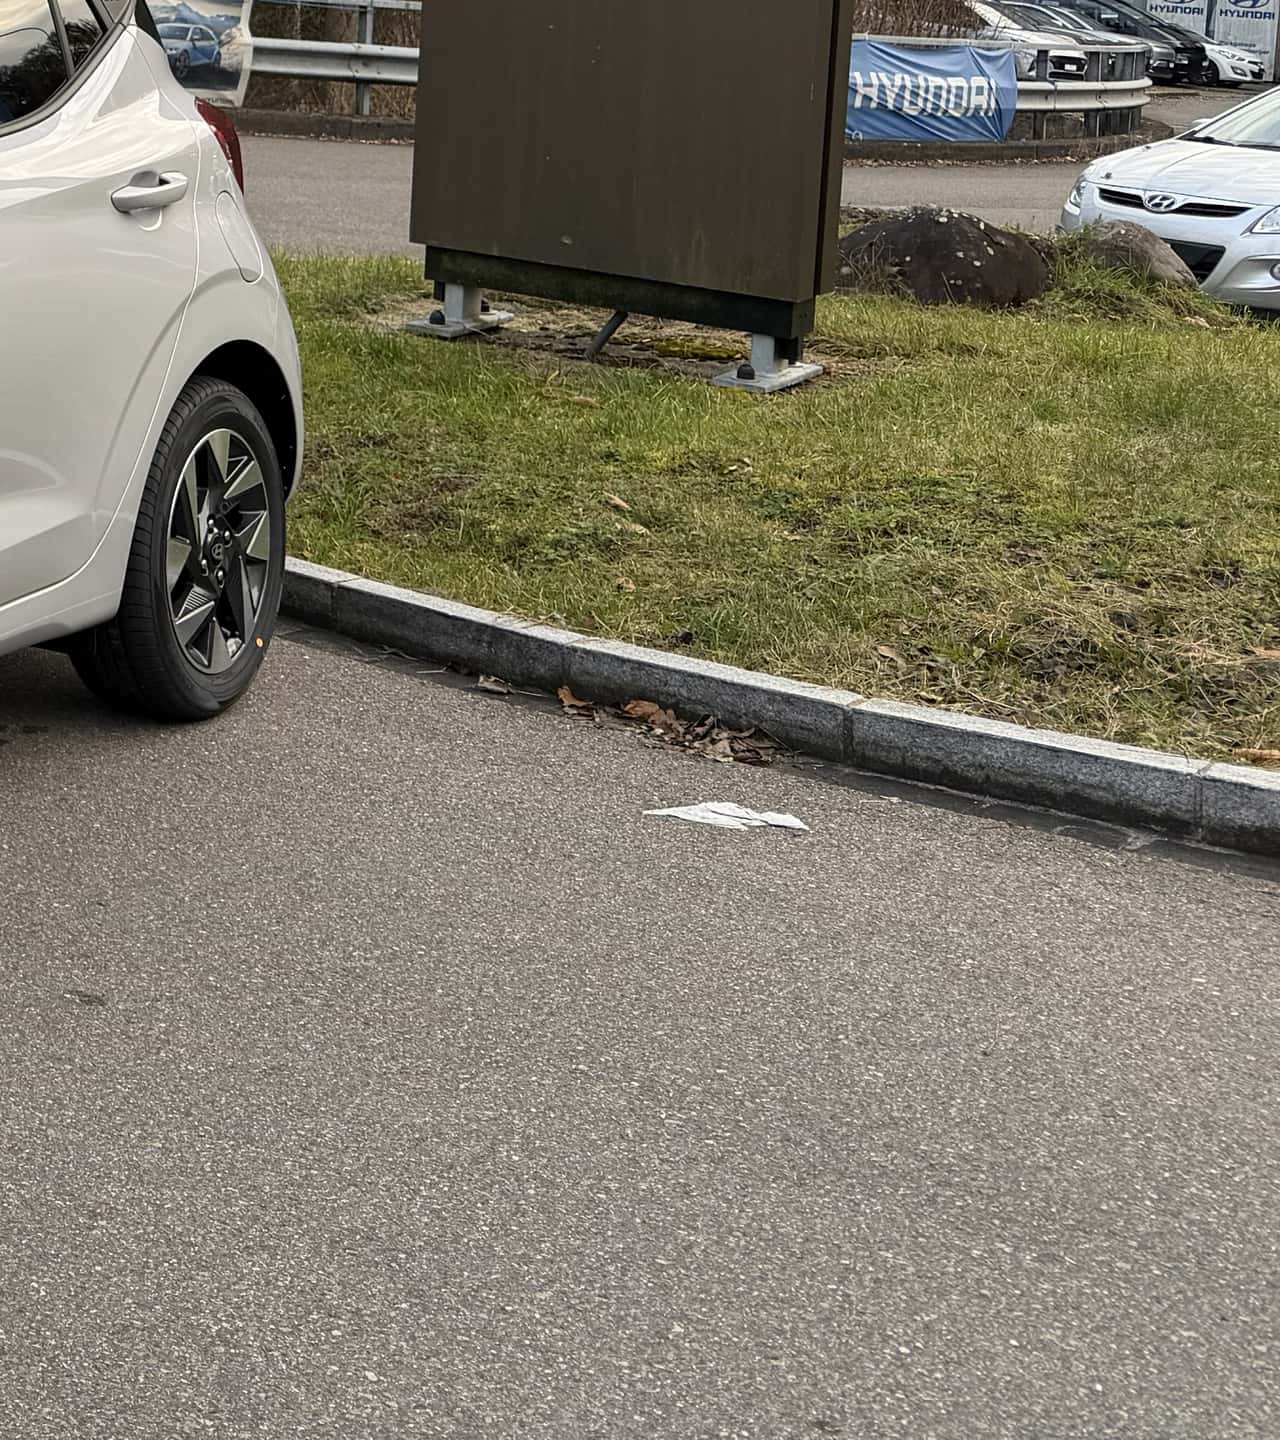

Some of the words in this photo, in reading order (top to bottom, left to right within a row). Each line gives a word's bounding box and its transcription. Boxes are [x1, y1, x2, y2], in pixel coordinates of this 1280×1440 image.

[1150, 4, 1204, 16] HYUNDAI
[1220, 8, 1275, 20] HYUNDAI
[850, 71, 997, 117] HYUNDAI
